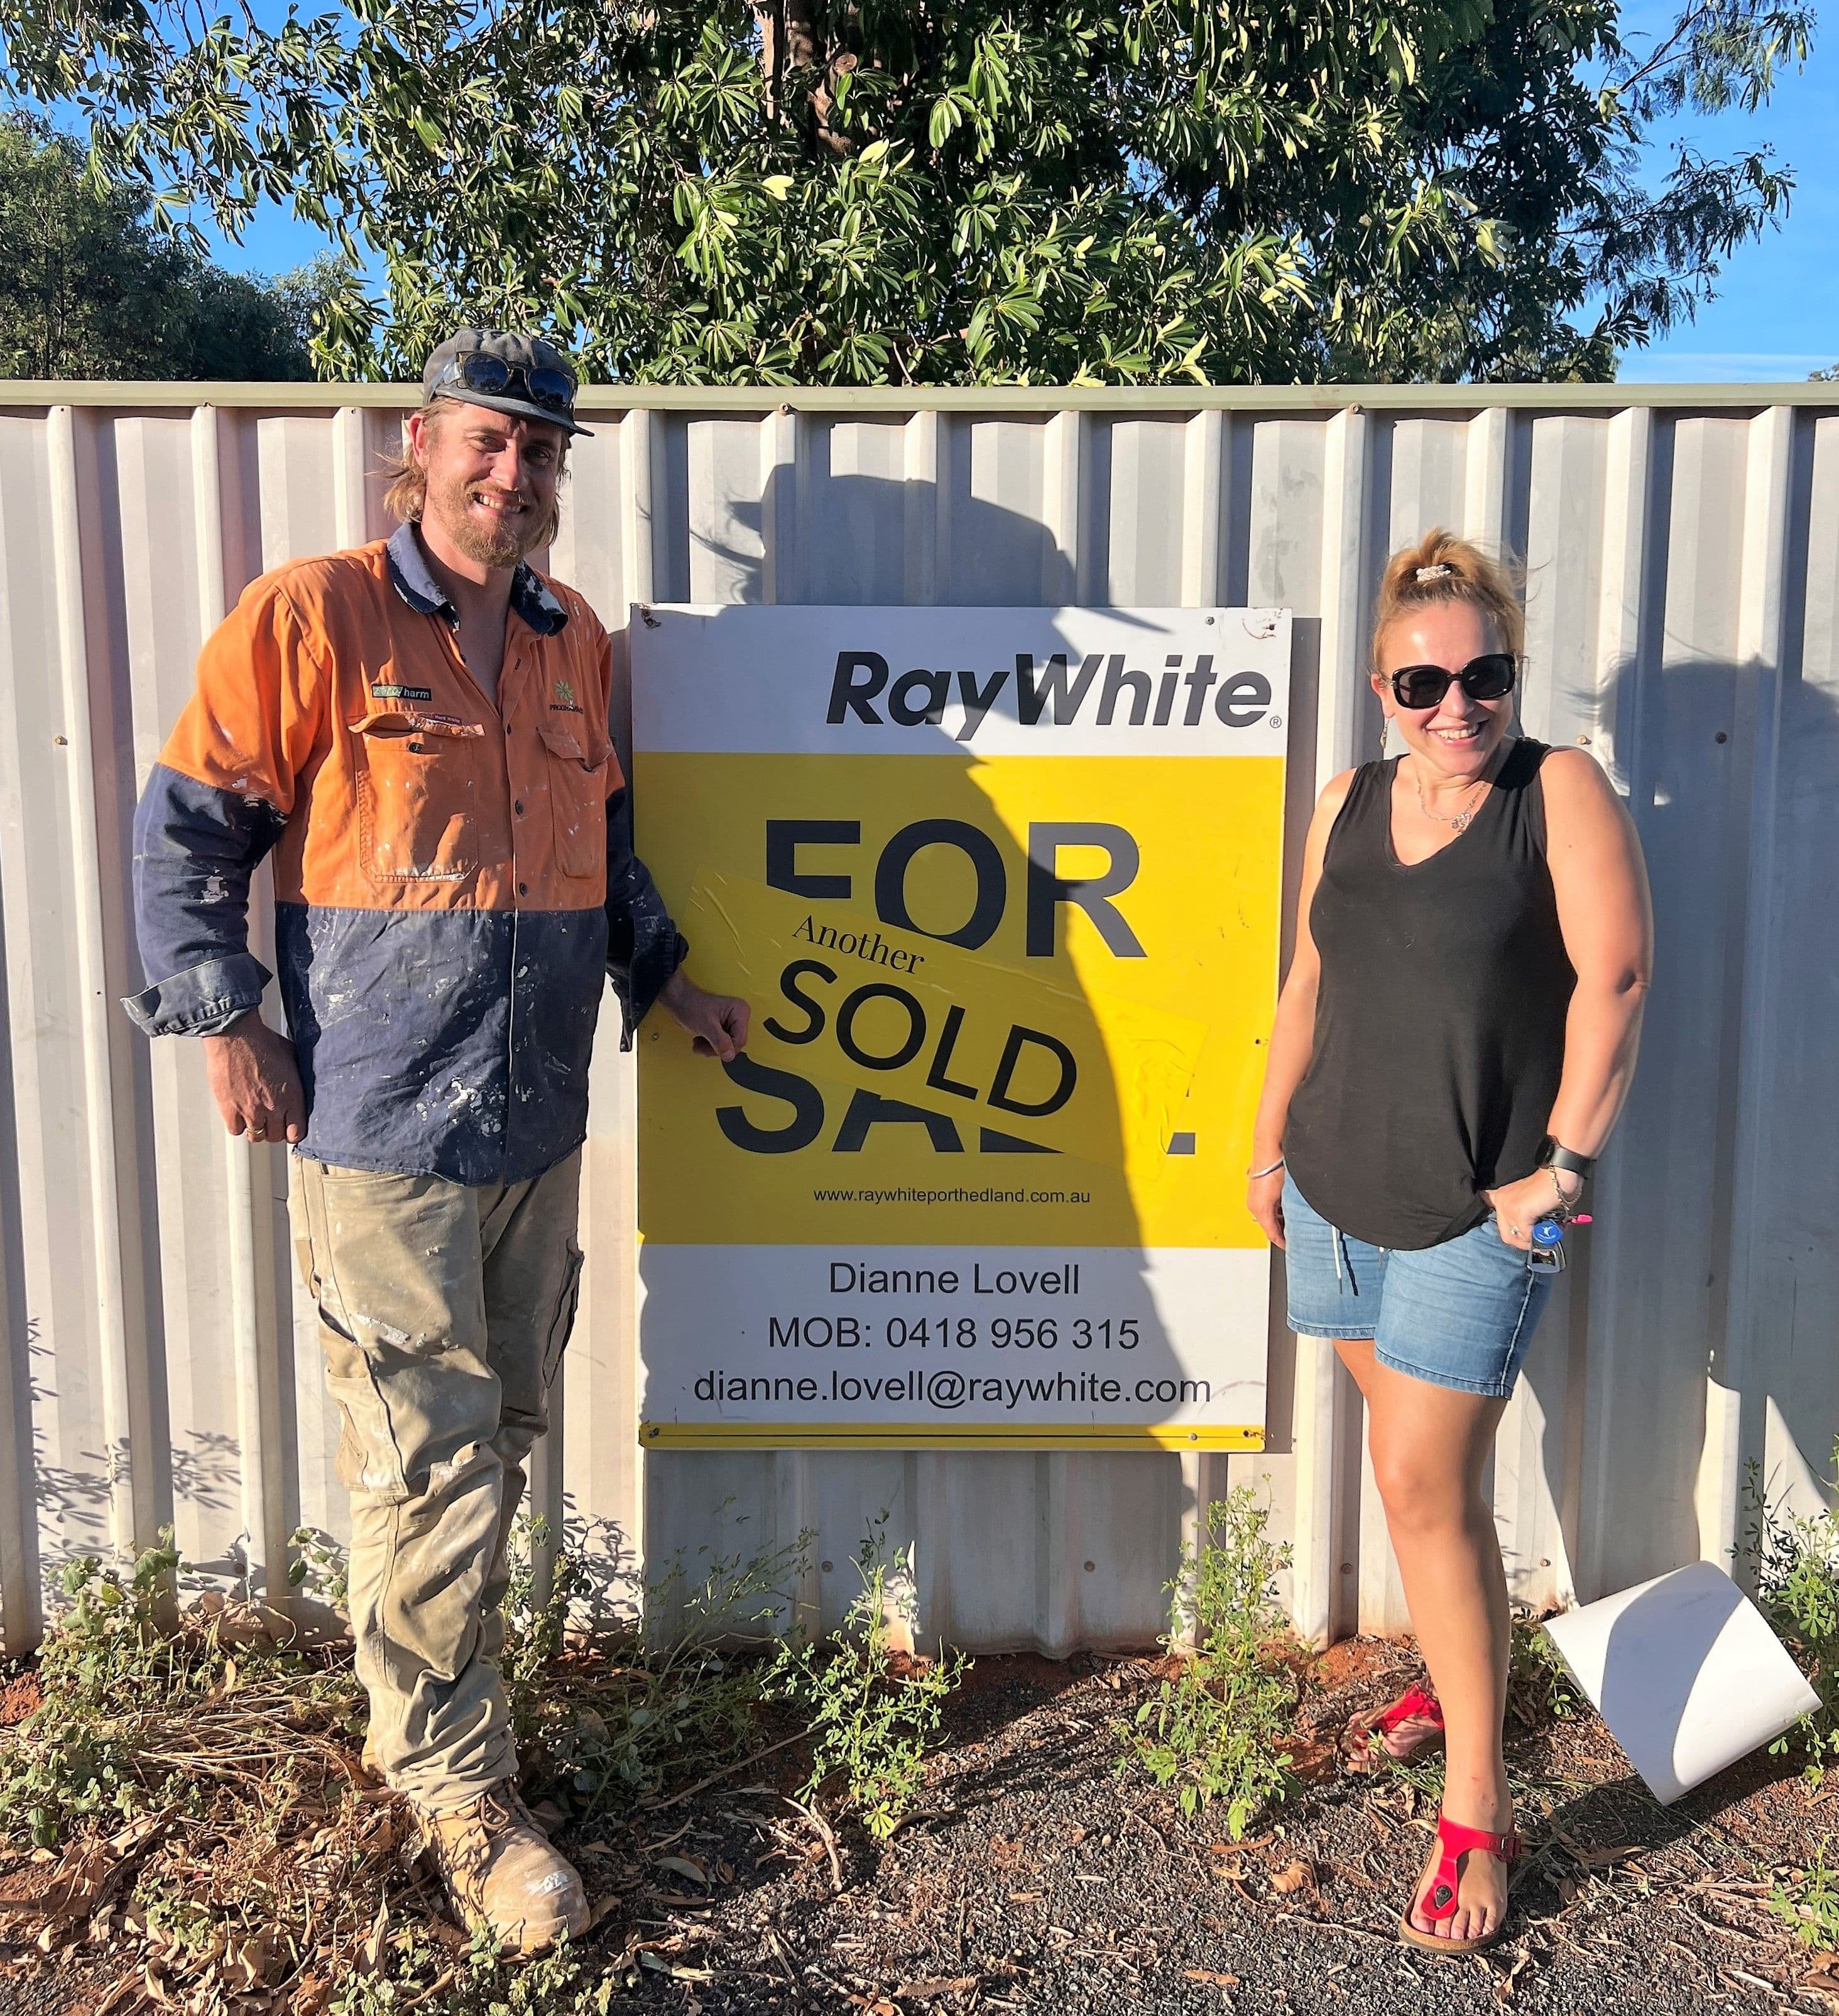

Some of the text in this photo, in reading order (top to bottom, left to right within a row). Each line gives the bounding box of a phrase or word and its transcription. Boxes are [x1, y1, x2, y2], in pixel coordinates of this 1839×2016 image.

[404, 687, 430, 699] harm
[766, 819, 1147, 958] FOR
[792, 914, 925, 974] Another
[763, 959, 1078, 1117] SOLD
[813, 1187, 1090, 1206] www.raywhiteporthedland.com.au
[830, 1262, 1079, 1294] Dianne Lovell
[769, 1317, 1139, 1349] MOB: 0418 956 315
[694, 1370, 1210, 1409] dianne.lovell@raywhite.com
